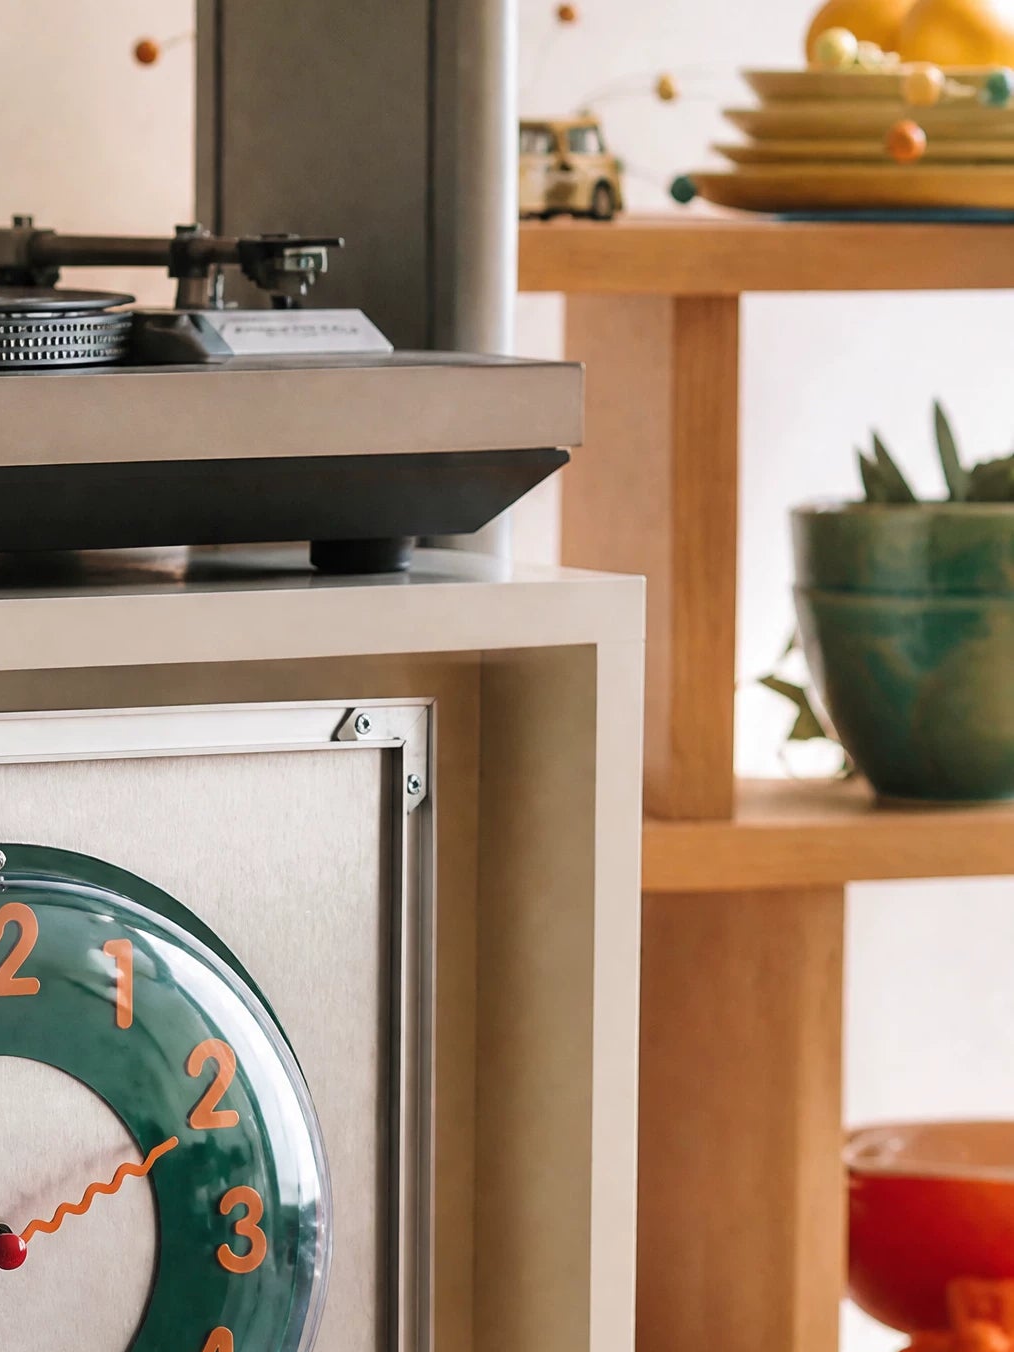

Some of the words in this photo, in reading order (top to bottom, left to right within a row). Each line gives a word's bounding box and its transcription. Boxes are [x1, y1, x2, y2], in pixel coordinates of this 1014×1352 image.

[104, 939, 133, 1029] 1
[186, 1040, 239, 1130] 2
[217, 1186, 267, 1273] 3
